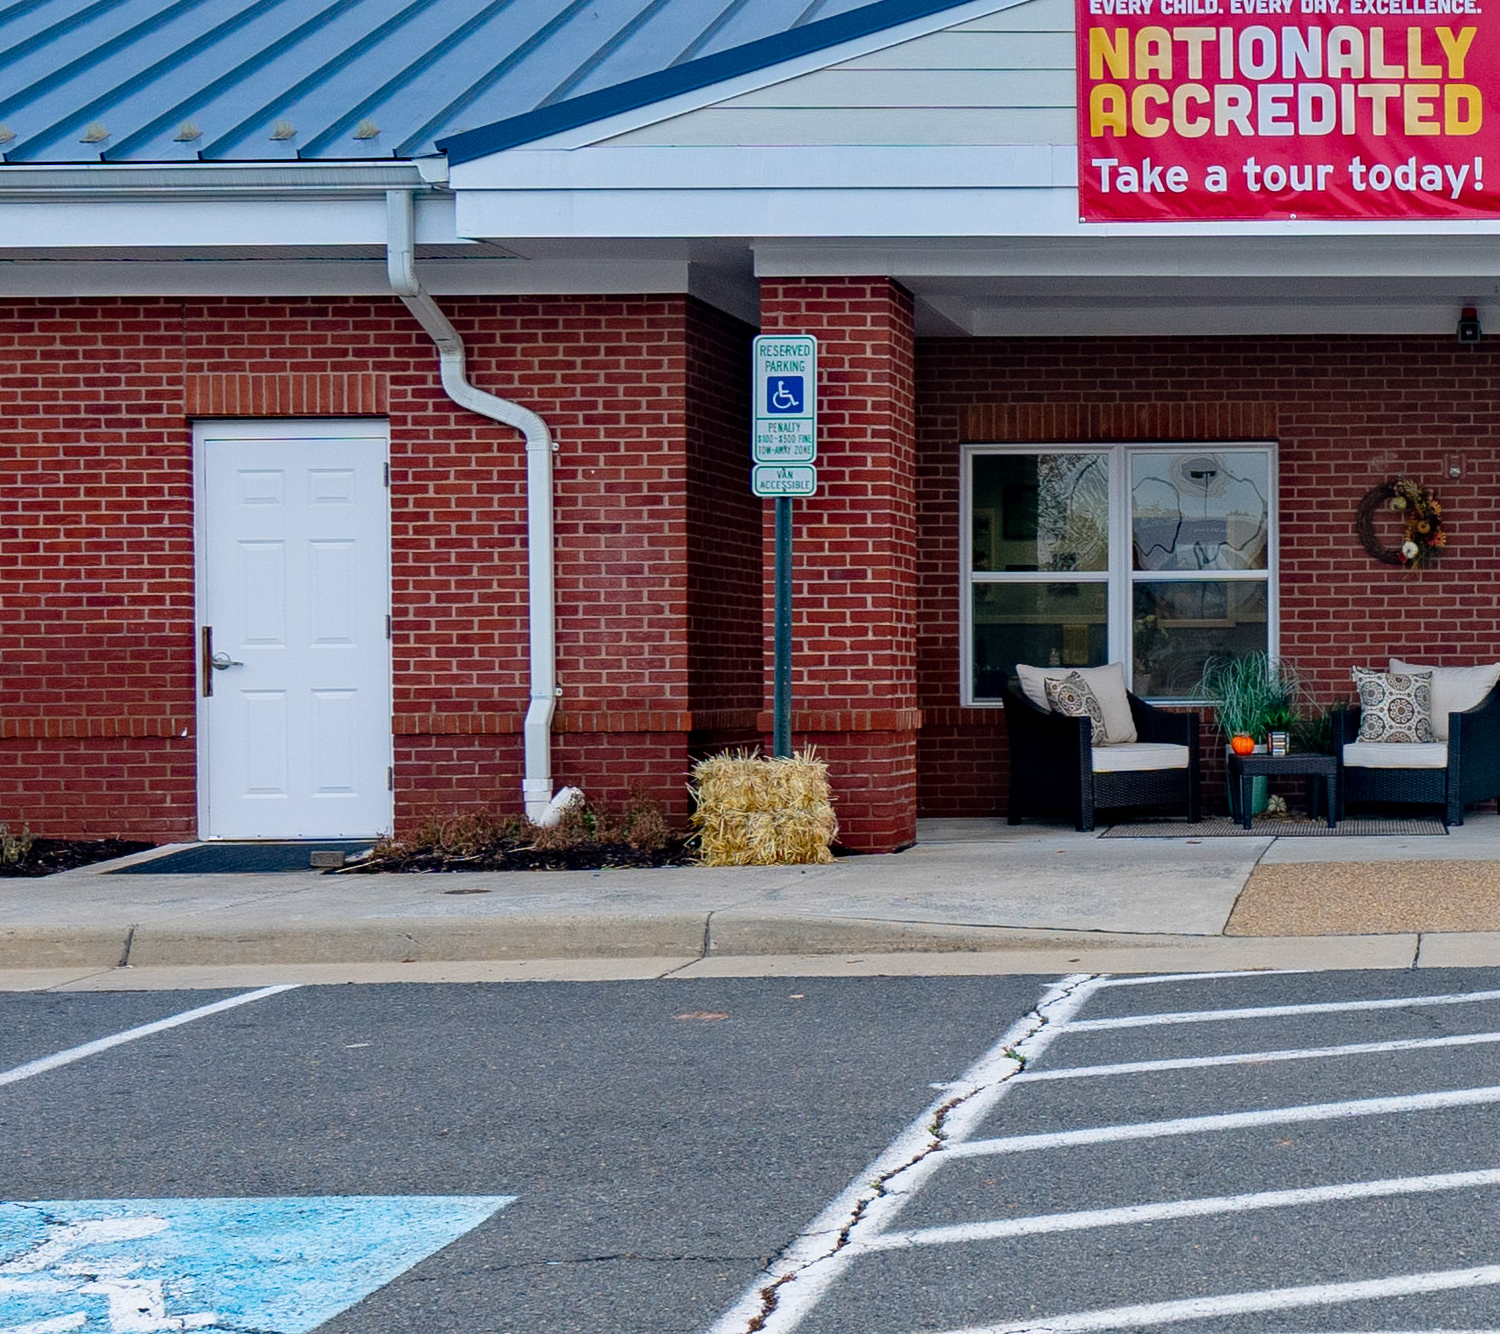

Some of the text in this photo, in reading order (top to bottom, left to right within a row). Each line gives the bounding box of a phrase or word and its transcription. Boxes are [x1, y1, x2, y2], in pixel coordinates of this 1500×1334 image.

[1089, 25, 1477, 80] NATIONALLY
[1090, 83, 1483, 138] ACCREDITED
[1091, 156, 1484, 199] Take a tour today!
[760, 345, 811, 357] RESERVED
[765, 361, 806, 373] PARKING
[768, 423, 801, 433] PENALTY
[798, 435, 812, 444] FINE
[758, 446, 812, 455] TOW-AWAY ZONE
[777, 471, 793, 479] VAN
[760, 481, 811, 490] ACCESSIBLE
